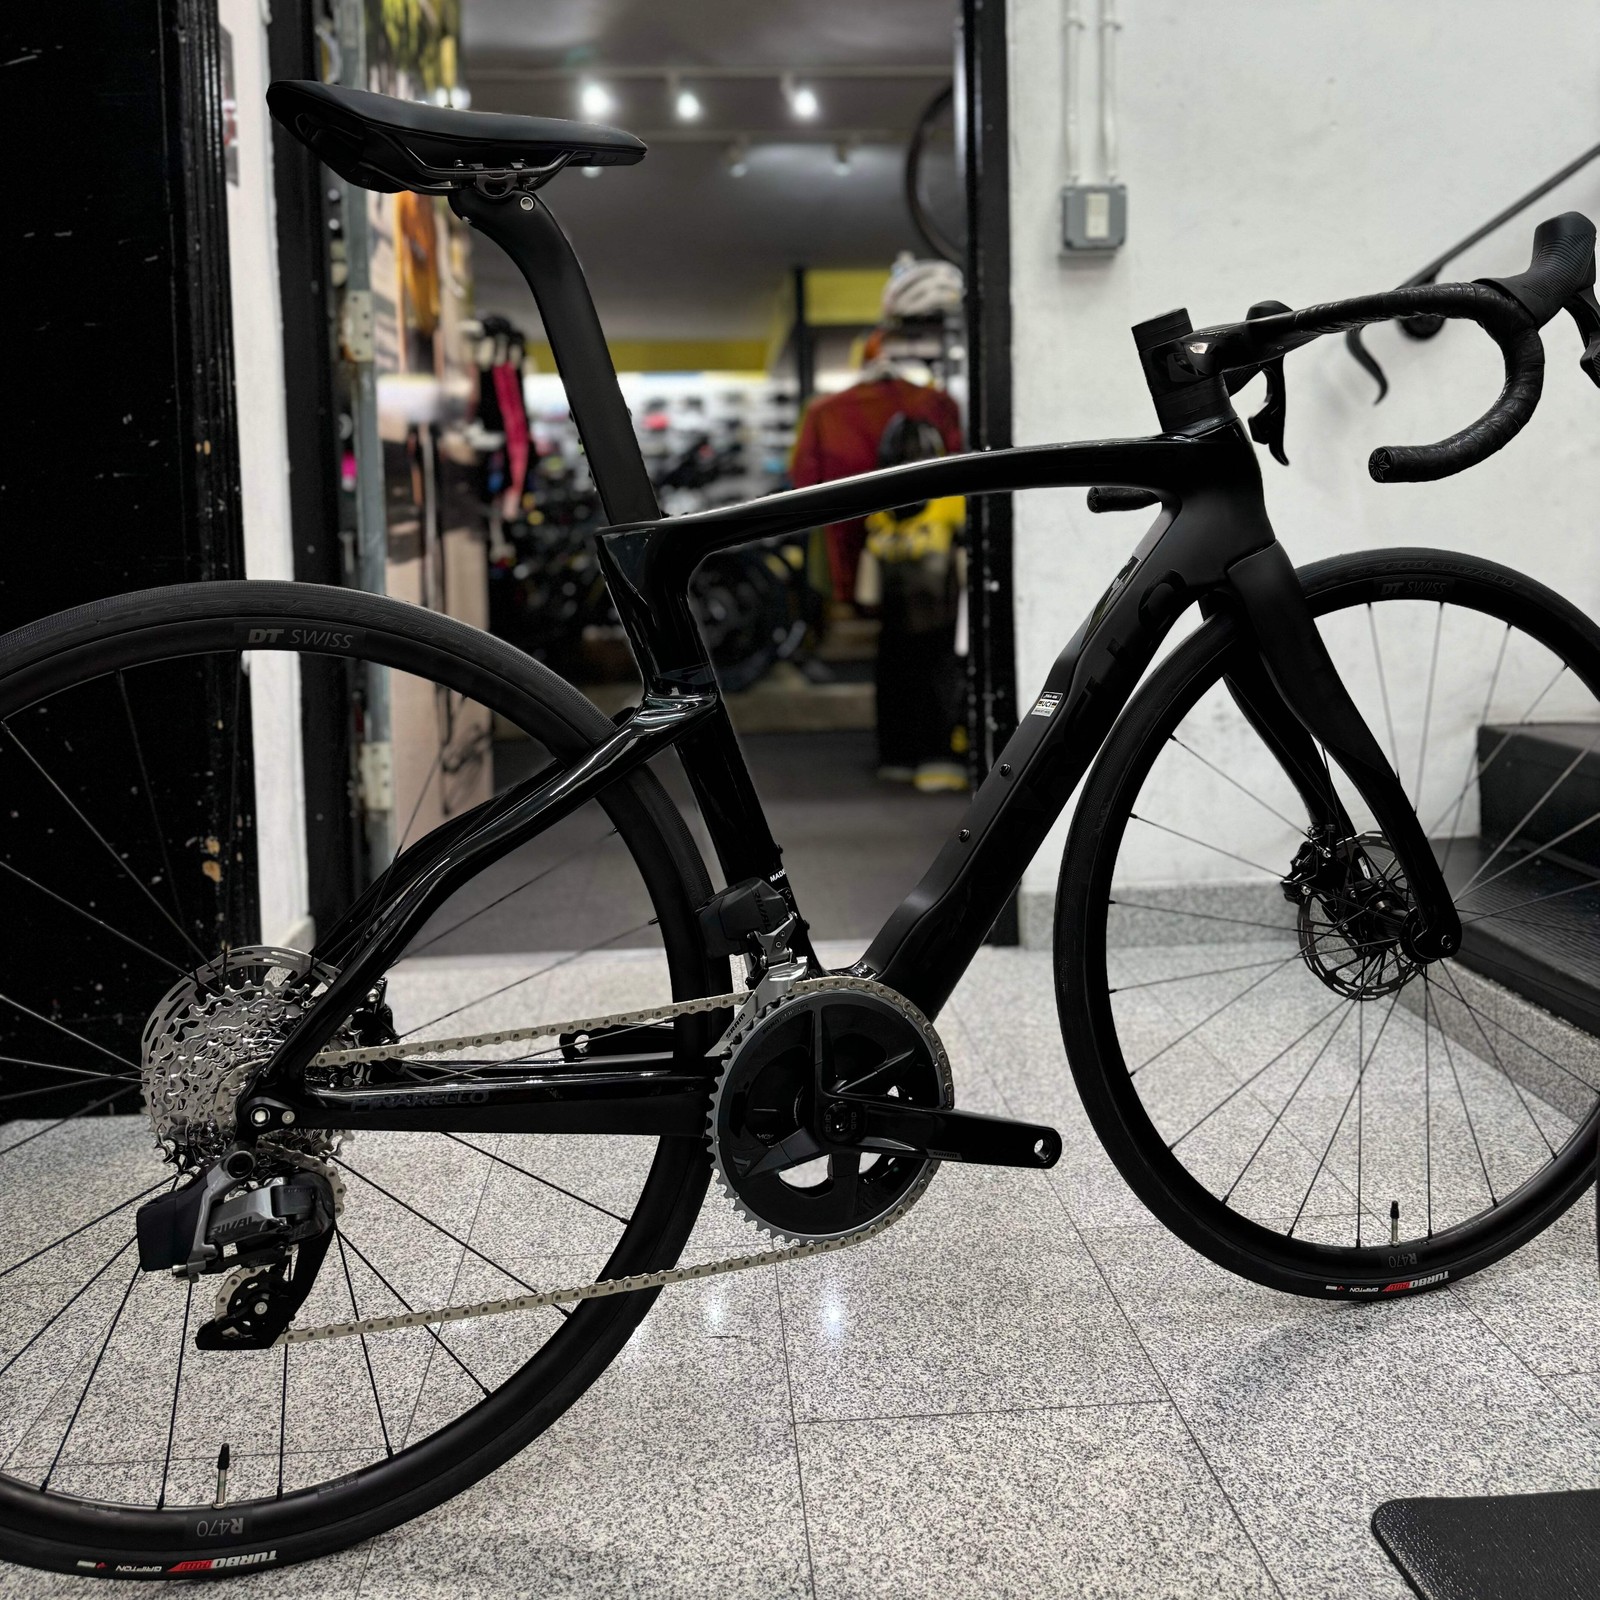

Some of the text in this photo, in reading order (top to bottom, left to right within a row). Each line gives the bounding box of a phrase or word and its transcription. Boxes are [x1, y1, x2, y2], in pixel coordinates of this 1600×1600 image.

[1379, 580, 1448, 595] DT SWISS
[248, 628, 354, 649] DT SWISS
[211, 1215, 255, 1234] RIVAL
[1388, 1252, 1418, 1269] R470
[1409, 1270, 1450, 1290] TURBO
[196, 1516, 244, 1538] R470
[114, 1563, 163, 1573] GRIPTON
[212, 1549, 278, 1569] TURBO
